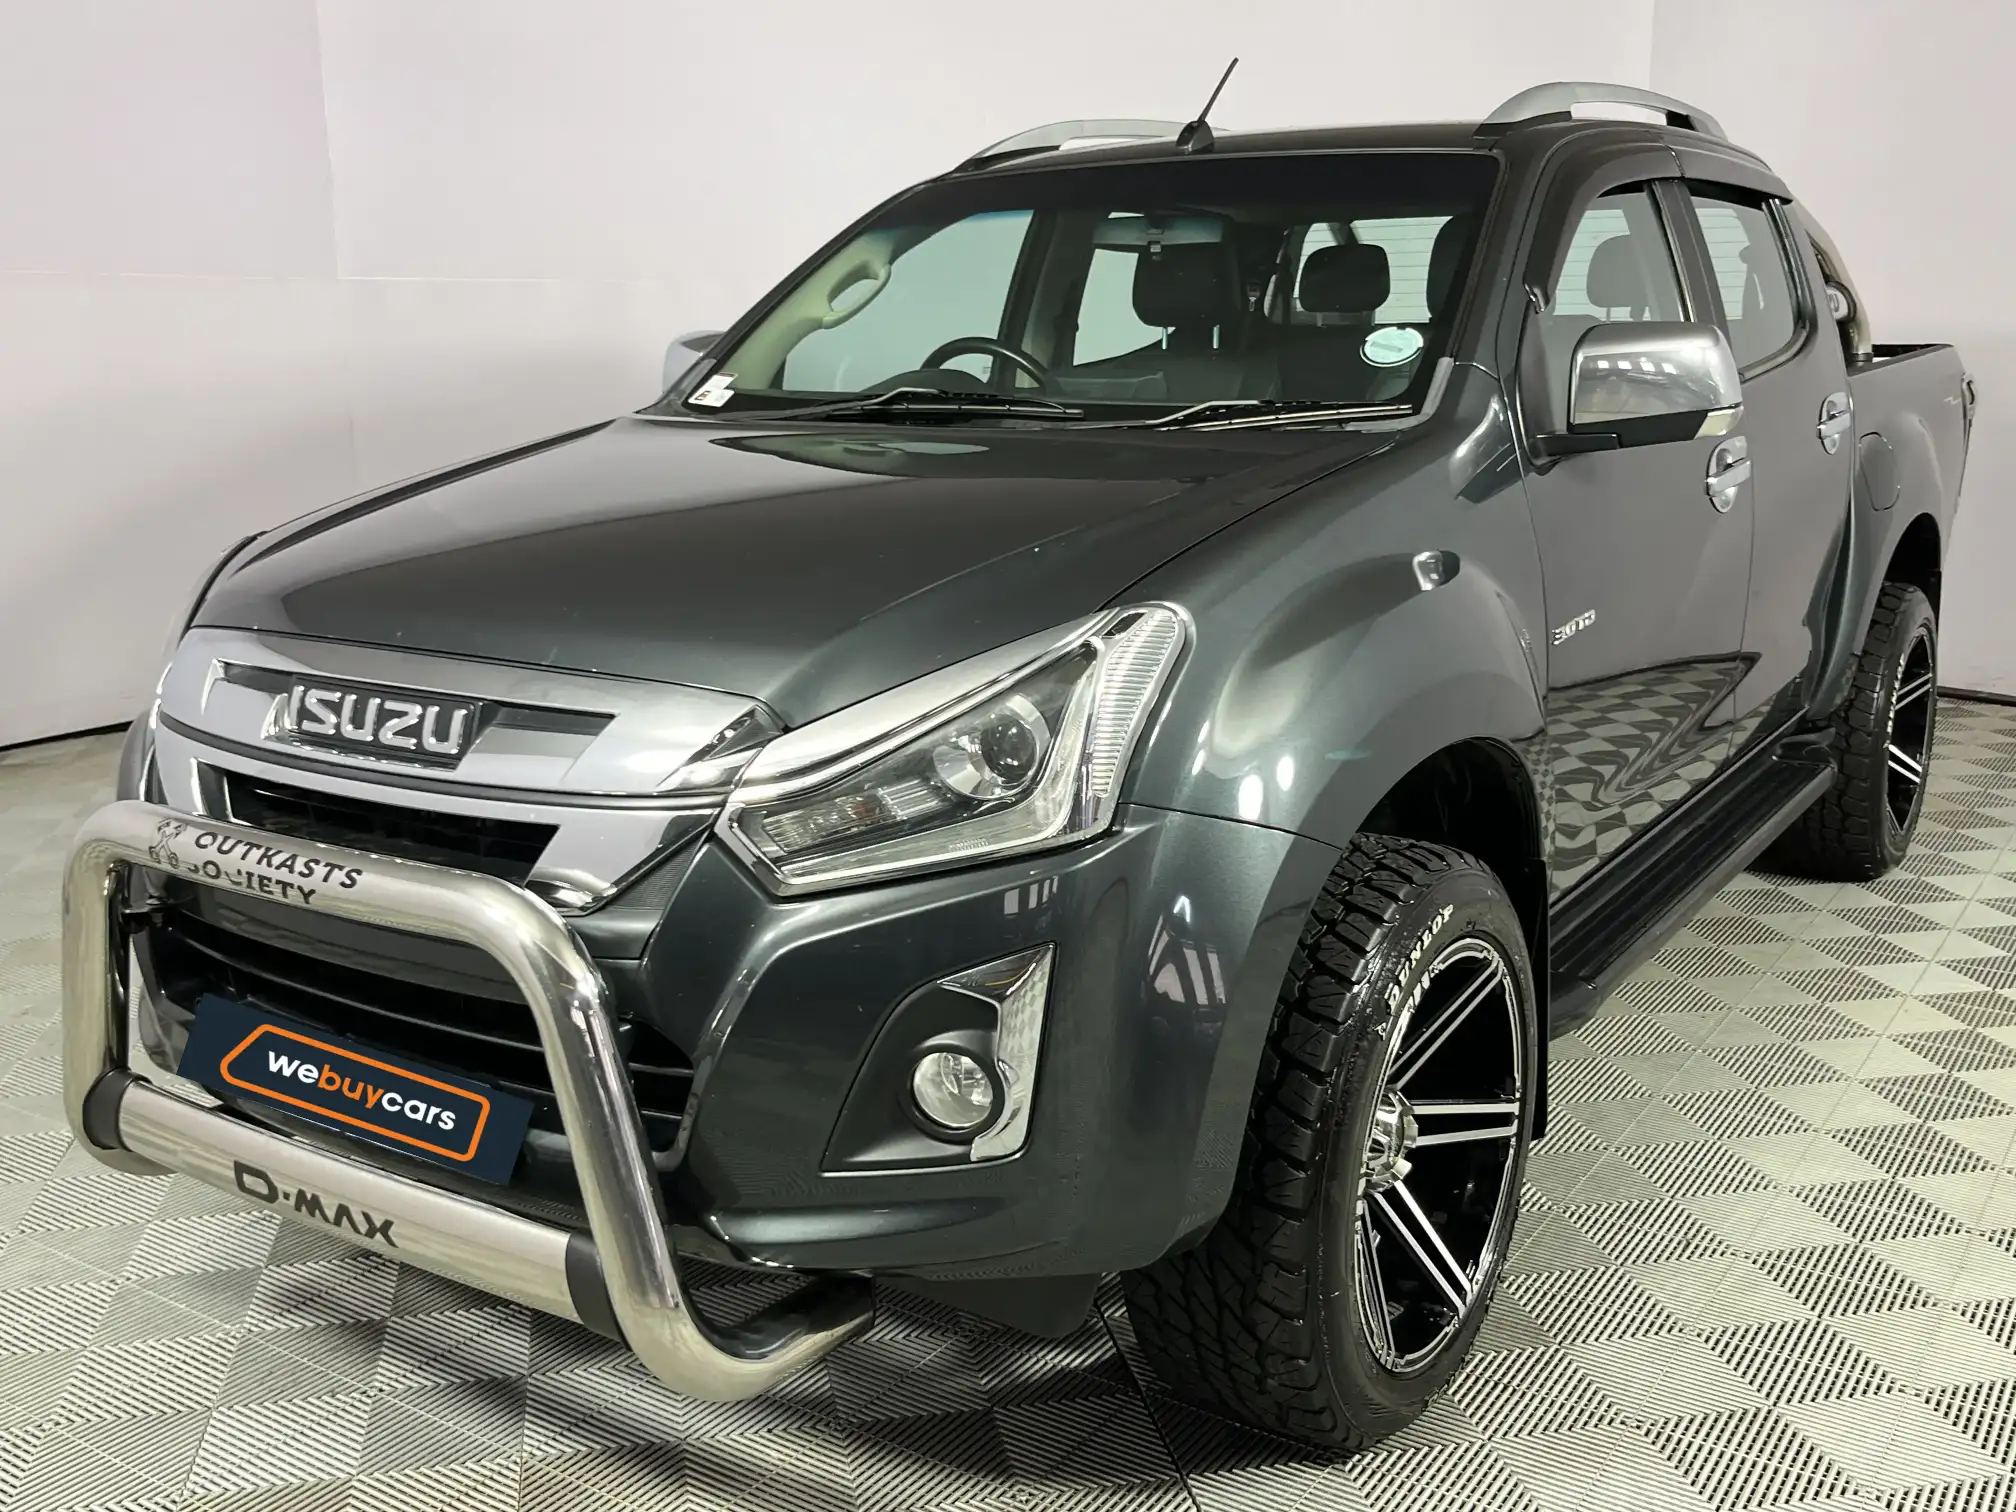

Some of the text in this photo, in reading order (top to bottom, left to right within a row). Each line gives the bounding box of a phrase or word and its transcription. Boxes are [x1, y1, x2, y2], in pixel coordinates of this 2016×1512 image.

[285, 685, 468, 754] ISUZU
[195, 831, 364, 889] OUTKASTS
[268, 1050, 457, 1131] webuycars
